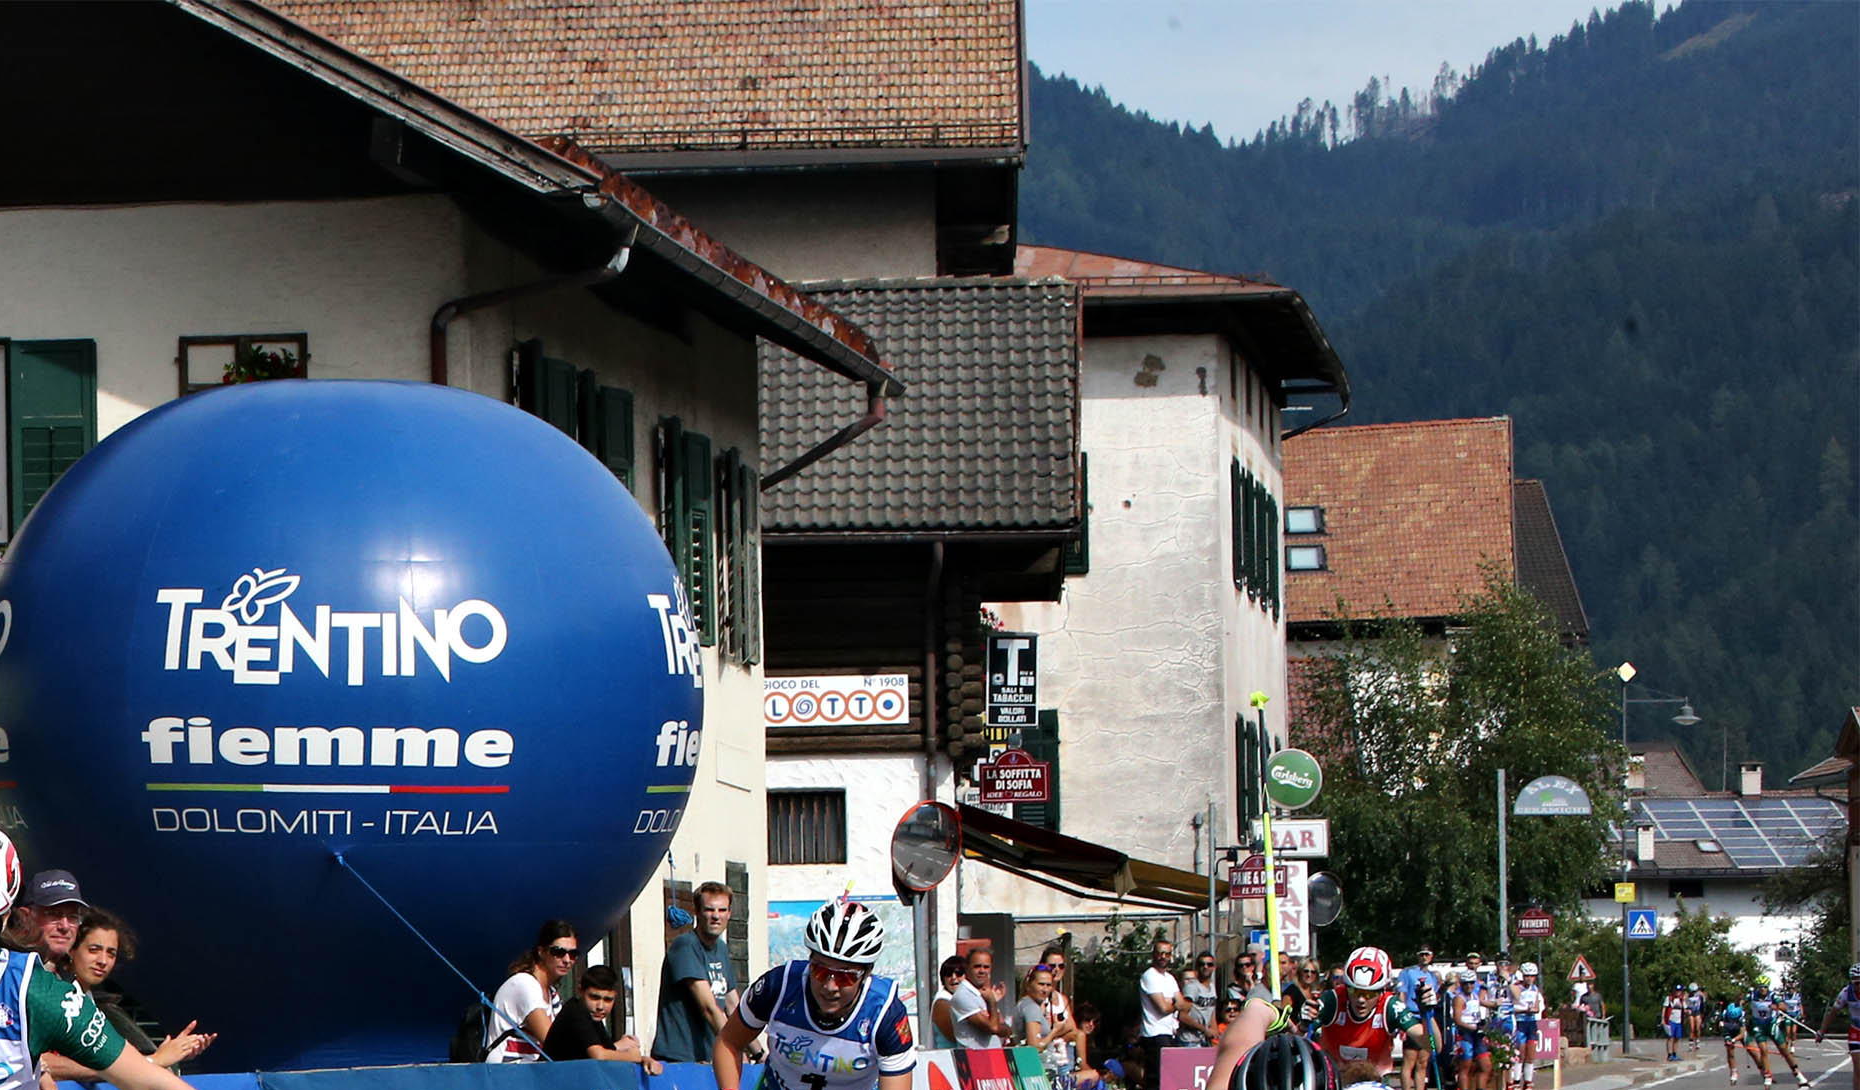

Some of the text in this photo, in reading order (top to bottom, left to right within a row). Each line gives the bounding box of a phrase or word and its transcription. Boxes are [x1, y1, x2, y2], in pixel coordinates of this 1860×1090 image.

[156, 588, 508, 687] TRENTINO
[800, 679, 821, 689] DEL
[879, 677, 905, 687] 1908
[992, 693, 1033, 703] TABACCHI
[1000, 707, 1026, 715] VALORI
[997, 714, 1027, 723] BOLLATI
[141, 717, 514, 768] fiemme
[986, 768, 1042, 779] LA SOFFITTA
[1271, 765, 1314, 789] Carlsberg
[995, 779, 1033, 790] DI SOFIA
[1013, 790, 1043, 799] REGALO
[152, 808, 352, 835] DOLOMITI
[384, 809, 499, 836] ITALIA
[1232, 872, 1252, 885] PANE
[1260, 870, 1284, 885] DCI
[92, 1034, 108, 1053] Audi
[775, 1033, 869, 1075] TRENTINO
